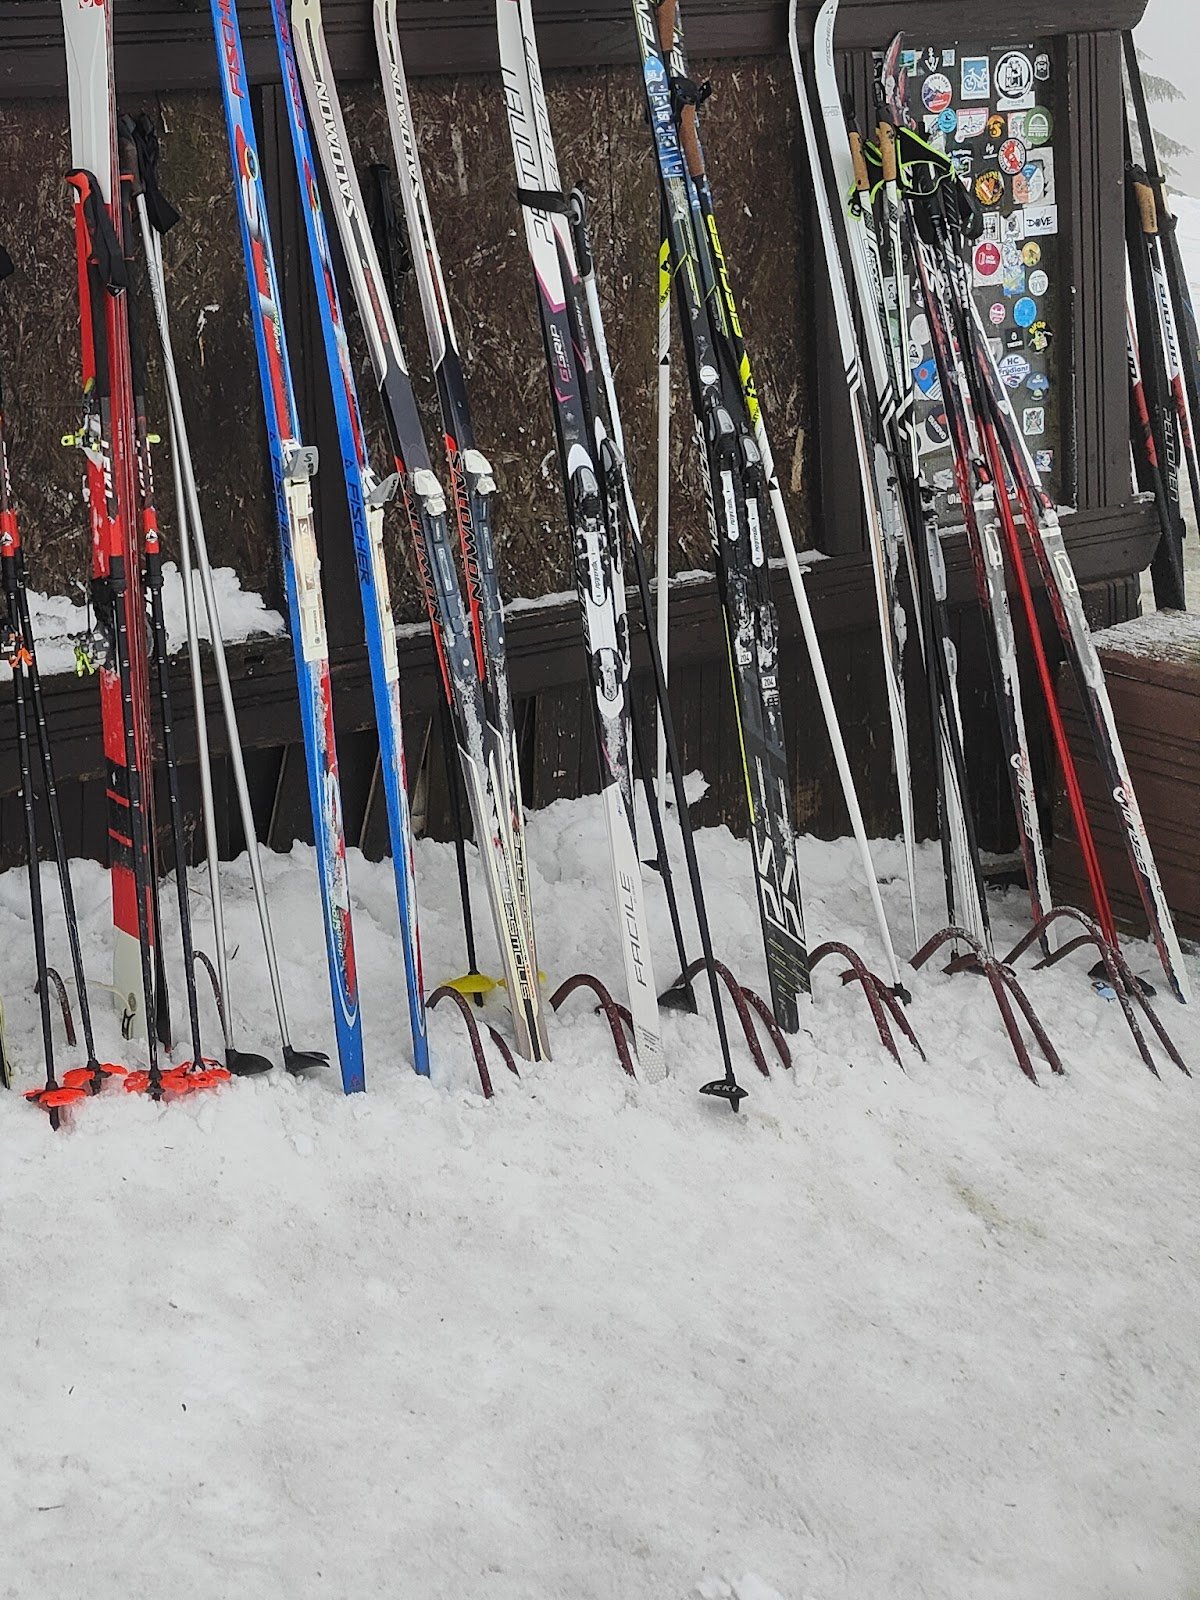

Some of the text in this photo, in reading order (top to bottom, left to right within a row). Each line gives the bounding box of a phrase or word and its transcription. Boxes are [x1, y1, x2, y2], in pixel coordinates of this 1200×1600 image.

[314, 80, 359, 220] SALOMON
[388, 62, 421, 200] SALOMON
[500, 66, 553, 245] PETONEN
[1007, 356, 1020, 366] HC
[692, 413, 720, 557] SPORTEN
[1163, 406, 1179, 503] PELTONEN
[349, 483, 371, 587] FISCHER
[448, 448, 484, 604] SALOMON
[620, 870, 647, 987] FACILE
[705, 1084, 738, 1093] LEKI
